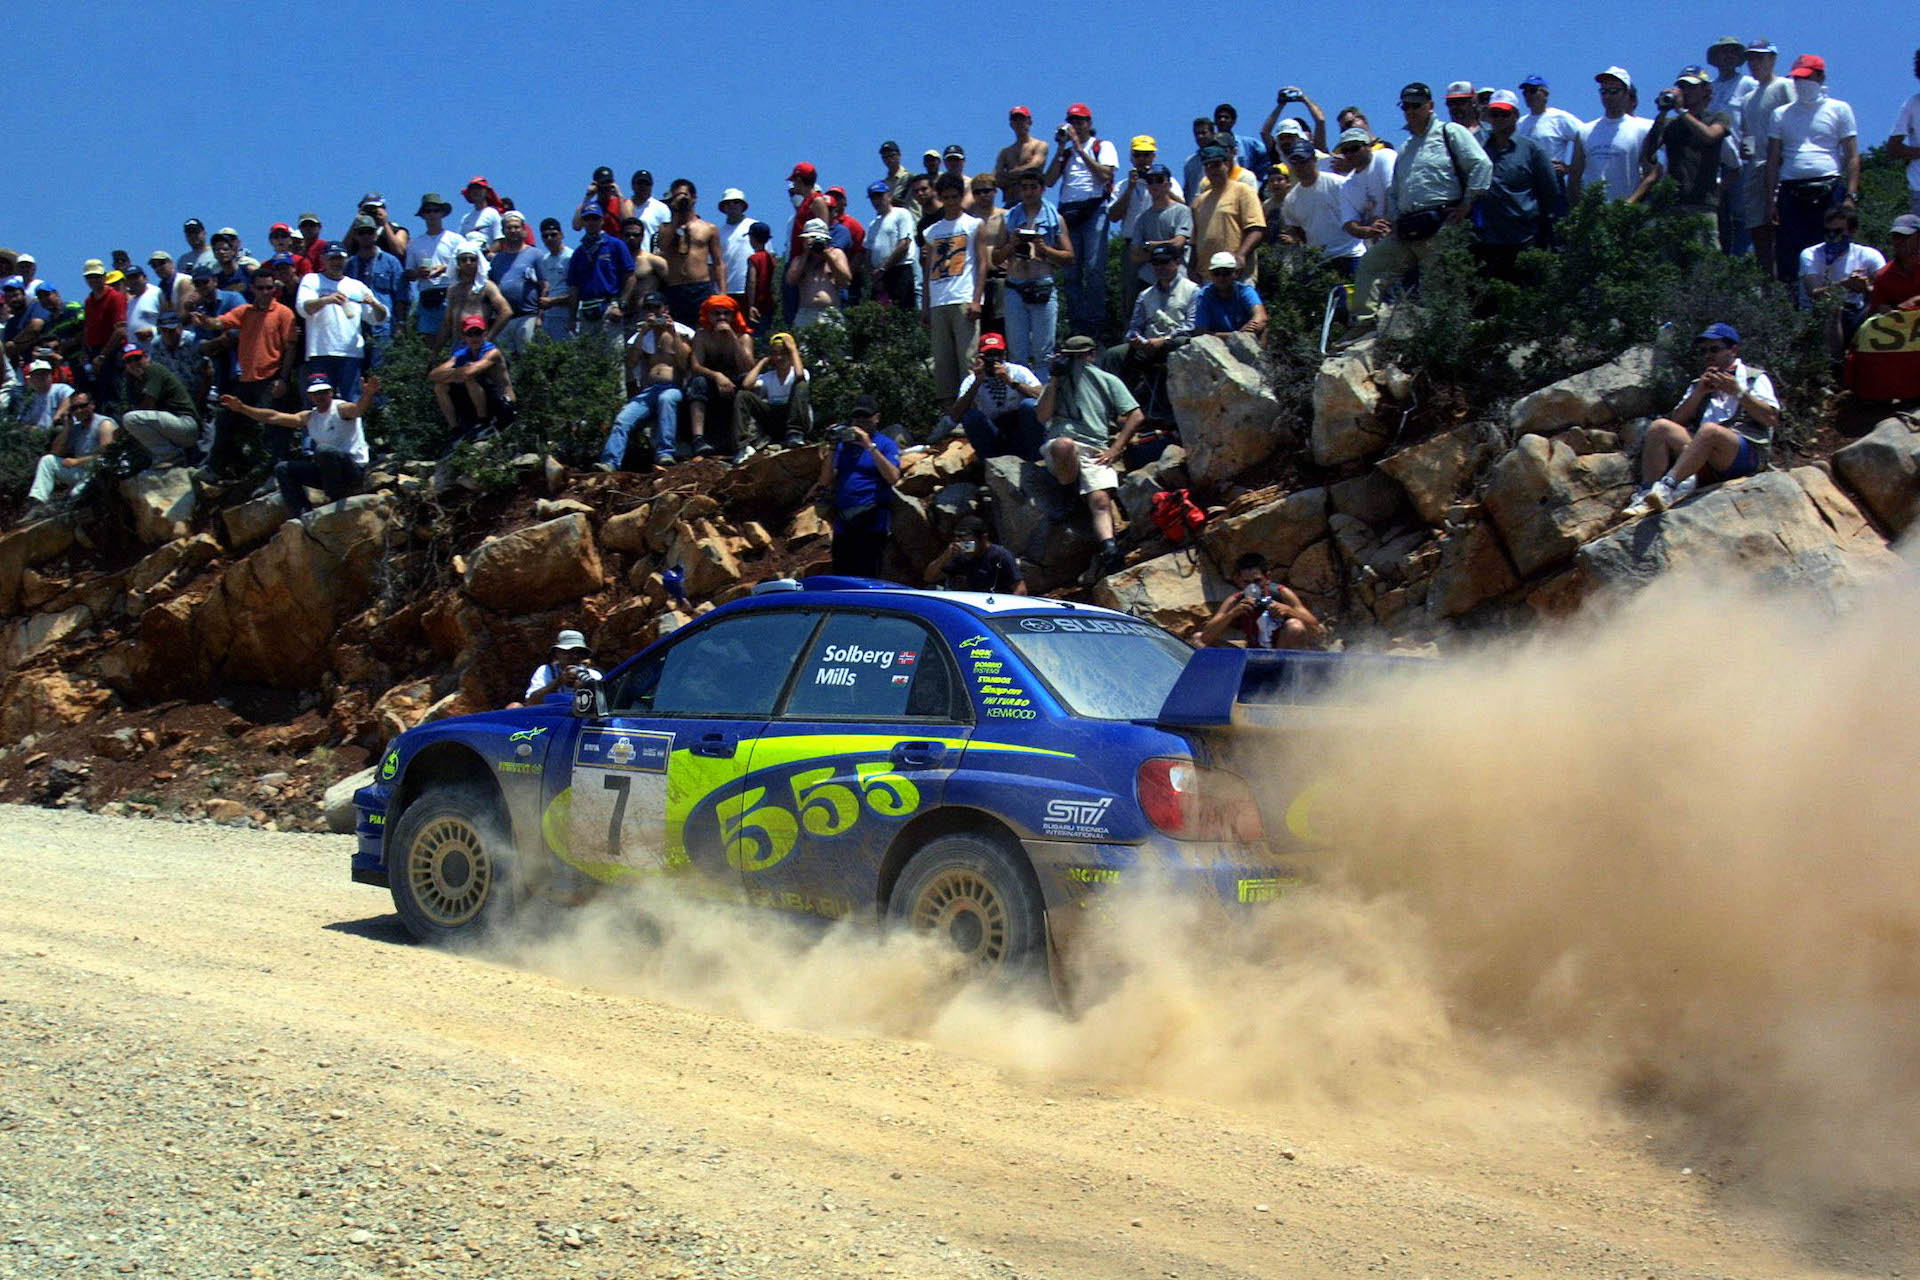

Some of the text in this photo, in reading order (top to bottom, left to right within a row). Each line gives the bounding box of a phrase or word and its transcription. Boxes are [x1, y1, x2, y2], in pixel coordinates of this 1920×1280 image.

[1053, 618, 1168, 639] SUBARU
[823, 645, 895, 669] Solberg
[815, 668, 857, 687] Mills
[997, 697, 1030, 707] TURBO
[986, 708, 1036, 719] KENWOOD
[604, 774, 631, 856] 7
[716, 761, 920, 873] 555
[1045, 830, 1105, 839] INTERNATIONAL
[1076, 825, 1109, 833] TECNICA
